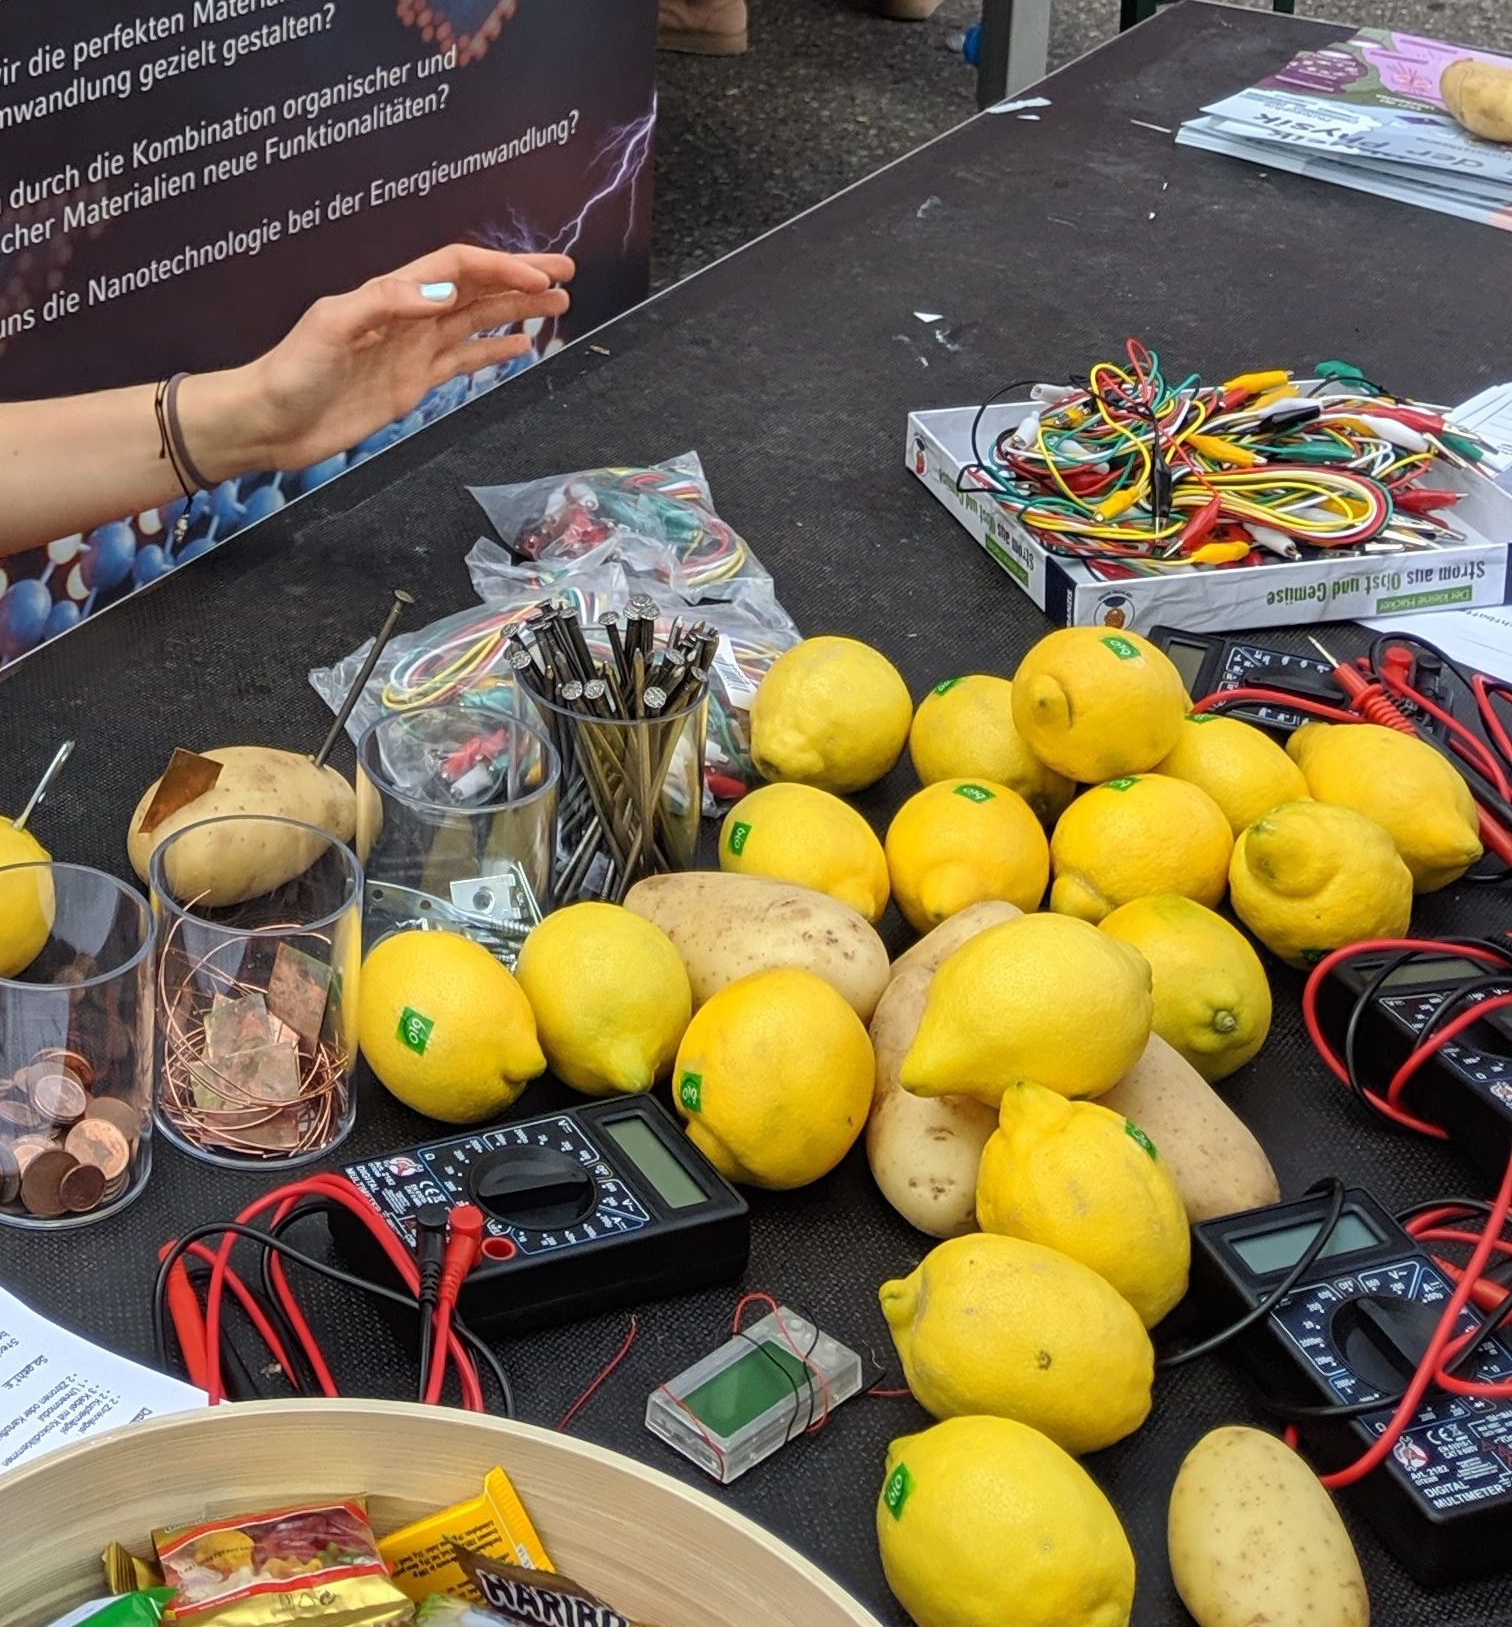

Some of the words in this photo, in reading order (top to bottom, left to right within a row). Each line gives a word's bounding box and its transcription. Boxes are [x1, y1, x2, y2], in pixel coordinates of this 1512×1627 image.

[28, 44, 65, 76] die
[73, 12, 183, 70] perfekten
[139, 40, 216, 91] gezielt
[222, 2, 334, 65] gestalten?
[9, 164, 78, 208] durch
[87, 151, 123, 182] die
[133, 105, 275, 168] Kombination
[283, 63, 410, 119] organischer
[417, 43, 456, 77] und
[63, 171, 194, 232] Materialien
[203, 151, 257, 185] neue
[265, 83, 449, 164] Funktionalitäten?
[43, 290, 79, 321] die
[88, 218, 281, 305] Nanotechnologie
[288, 200, 319, 233] bei
[327, 191, 363, 219] der
[370, 109, 579, 205] Energieumwandlung?
[1407, 569, 1433, 586] aus
[1439, 560, 1485, 580] Strom
[1267, 582, 1326, 607] Gemüse
[1332, 578, 1359, 600] und
[1365, 572, 1401, 595] Obst
[408, 1018, 427, 1044] bio
[1424, 1481, 1470, 1498] DIGITAL
[1432, 1484, 1506, 1509] MULTIMETER
